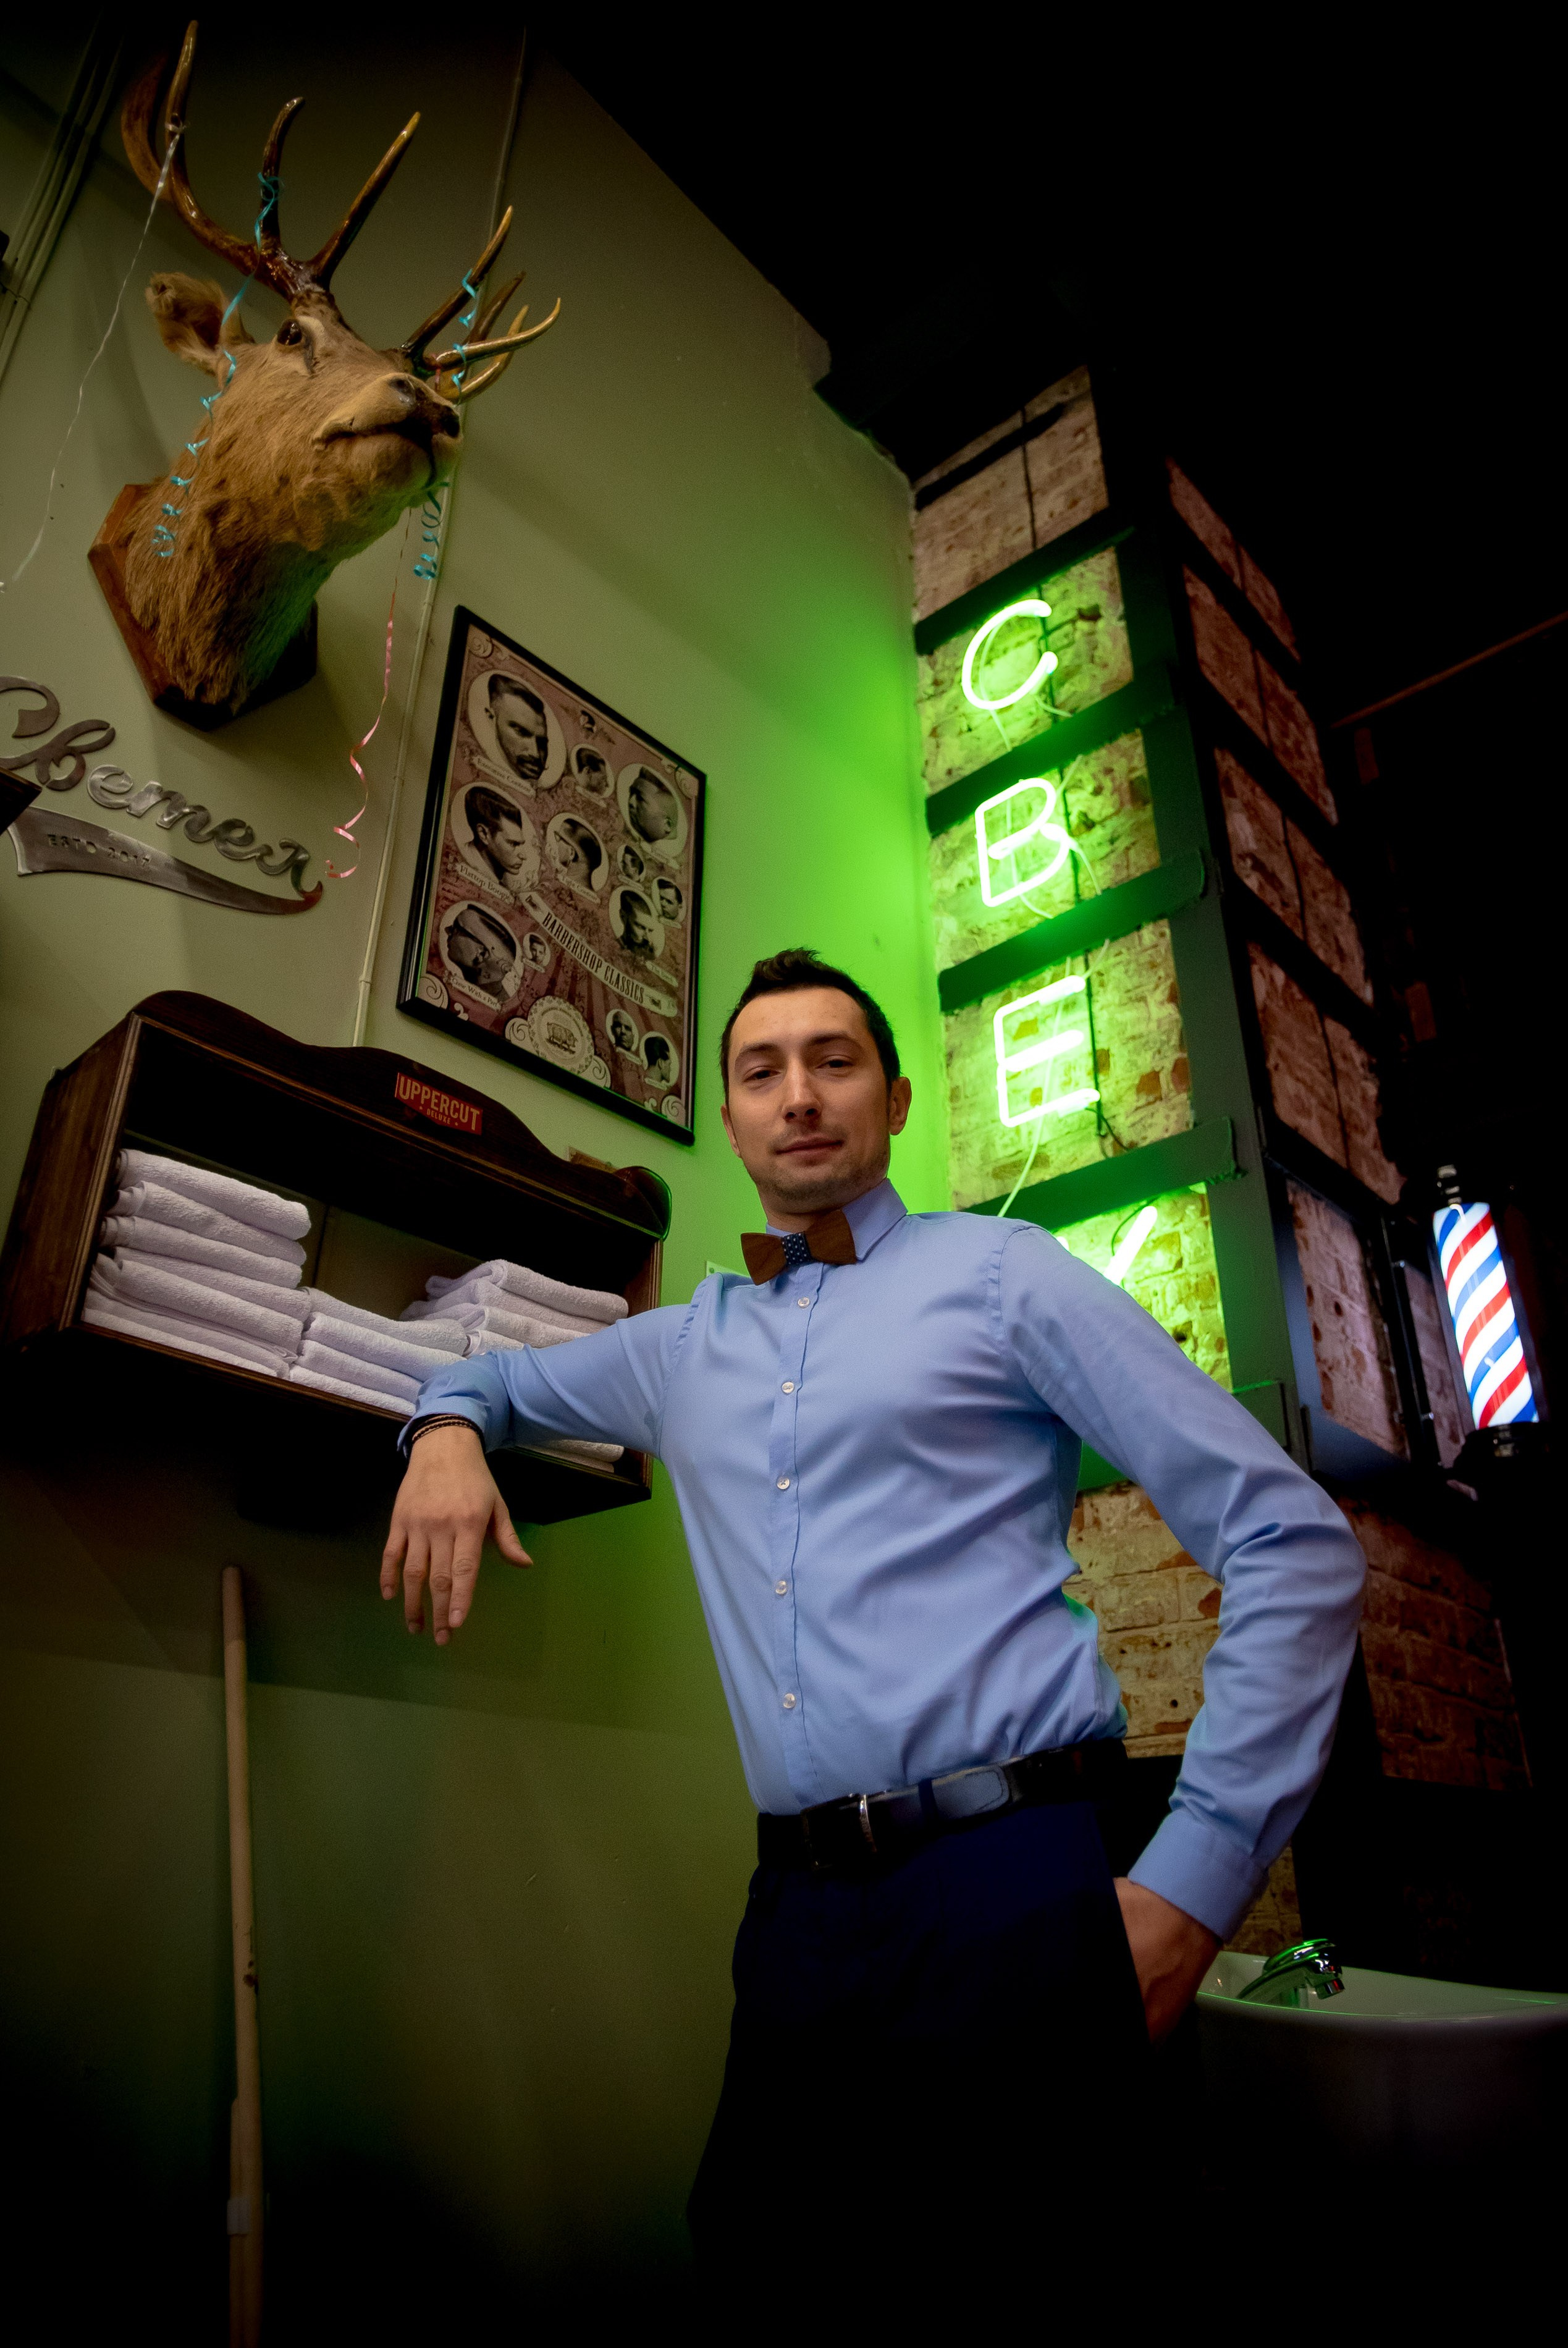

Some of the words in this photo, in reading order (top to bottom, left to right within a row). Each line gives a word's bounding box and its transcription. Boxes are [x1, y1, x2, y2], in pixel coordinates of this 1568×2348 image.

[47, 834, 97, 855] ESTD
[542, 911, 603, 973] BARBERSHOP
[604, 965, 644, 1004] CLASSICS
[398, 1075, 480, 1131] UPPERCUT
[426, 1108, 451, 1125] DELUXE
